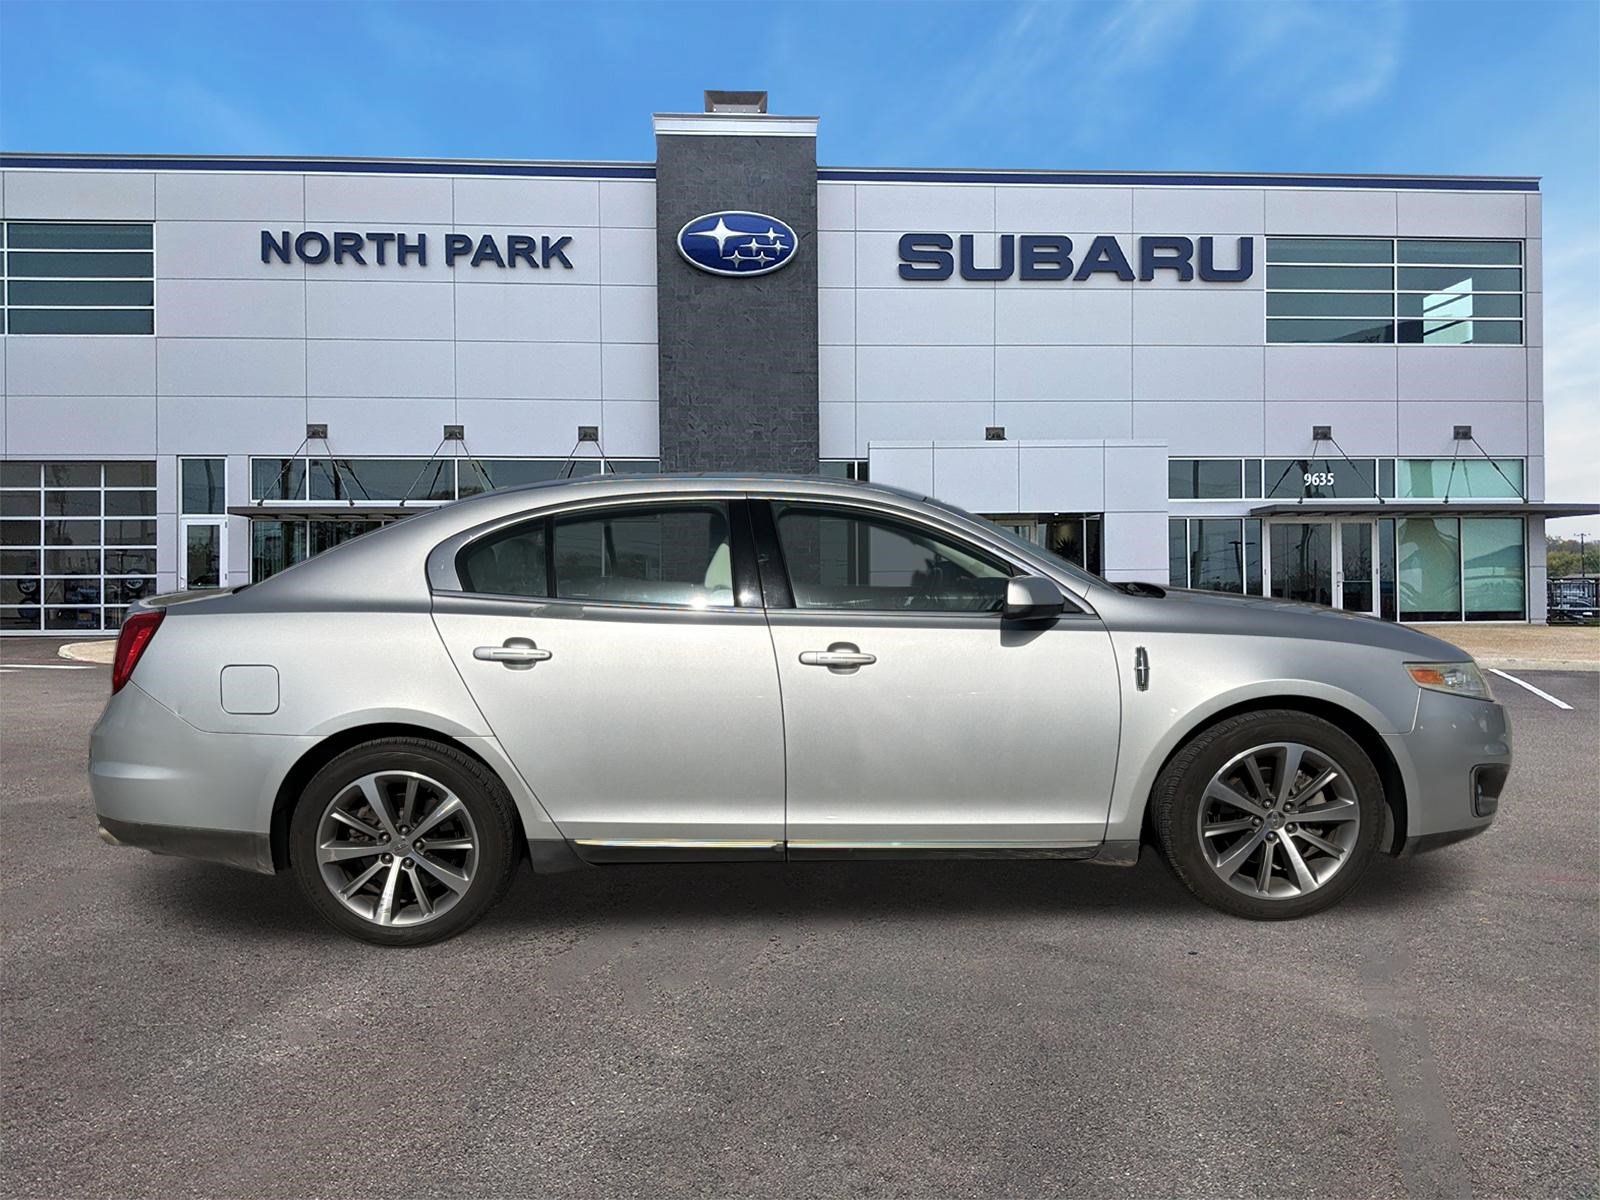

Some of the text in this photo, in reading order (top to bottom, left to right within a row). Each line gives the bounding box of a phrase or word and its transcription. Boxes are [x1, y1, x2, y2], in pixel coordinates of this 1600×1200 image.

[260, 230, 574, 269] NORTH PARK
[898, 232, 1254, 282] SUBARU
[1303, 472, 1335, 486] 9635
